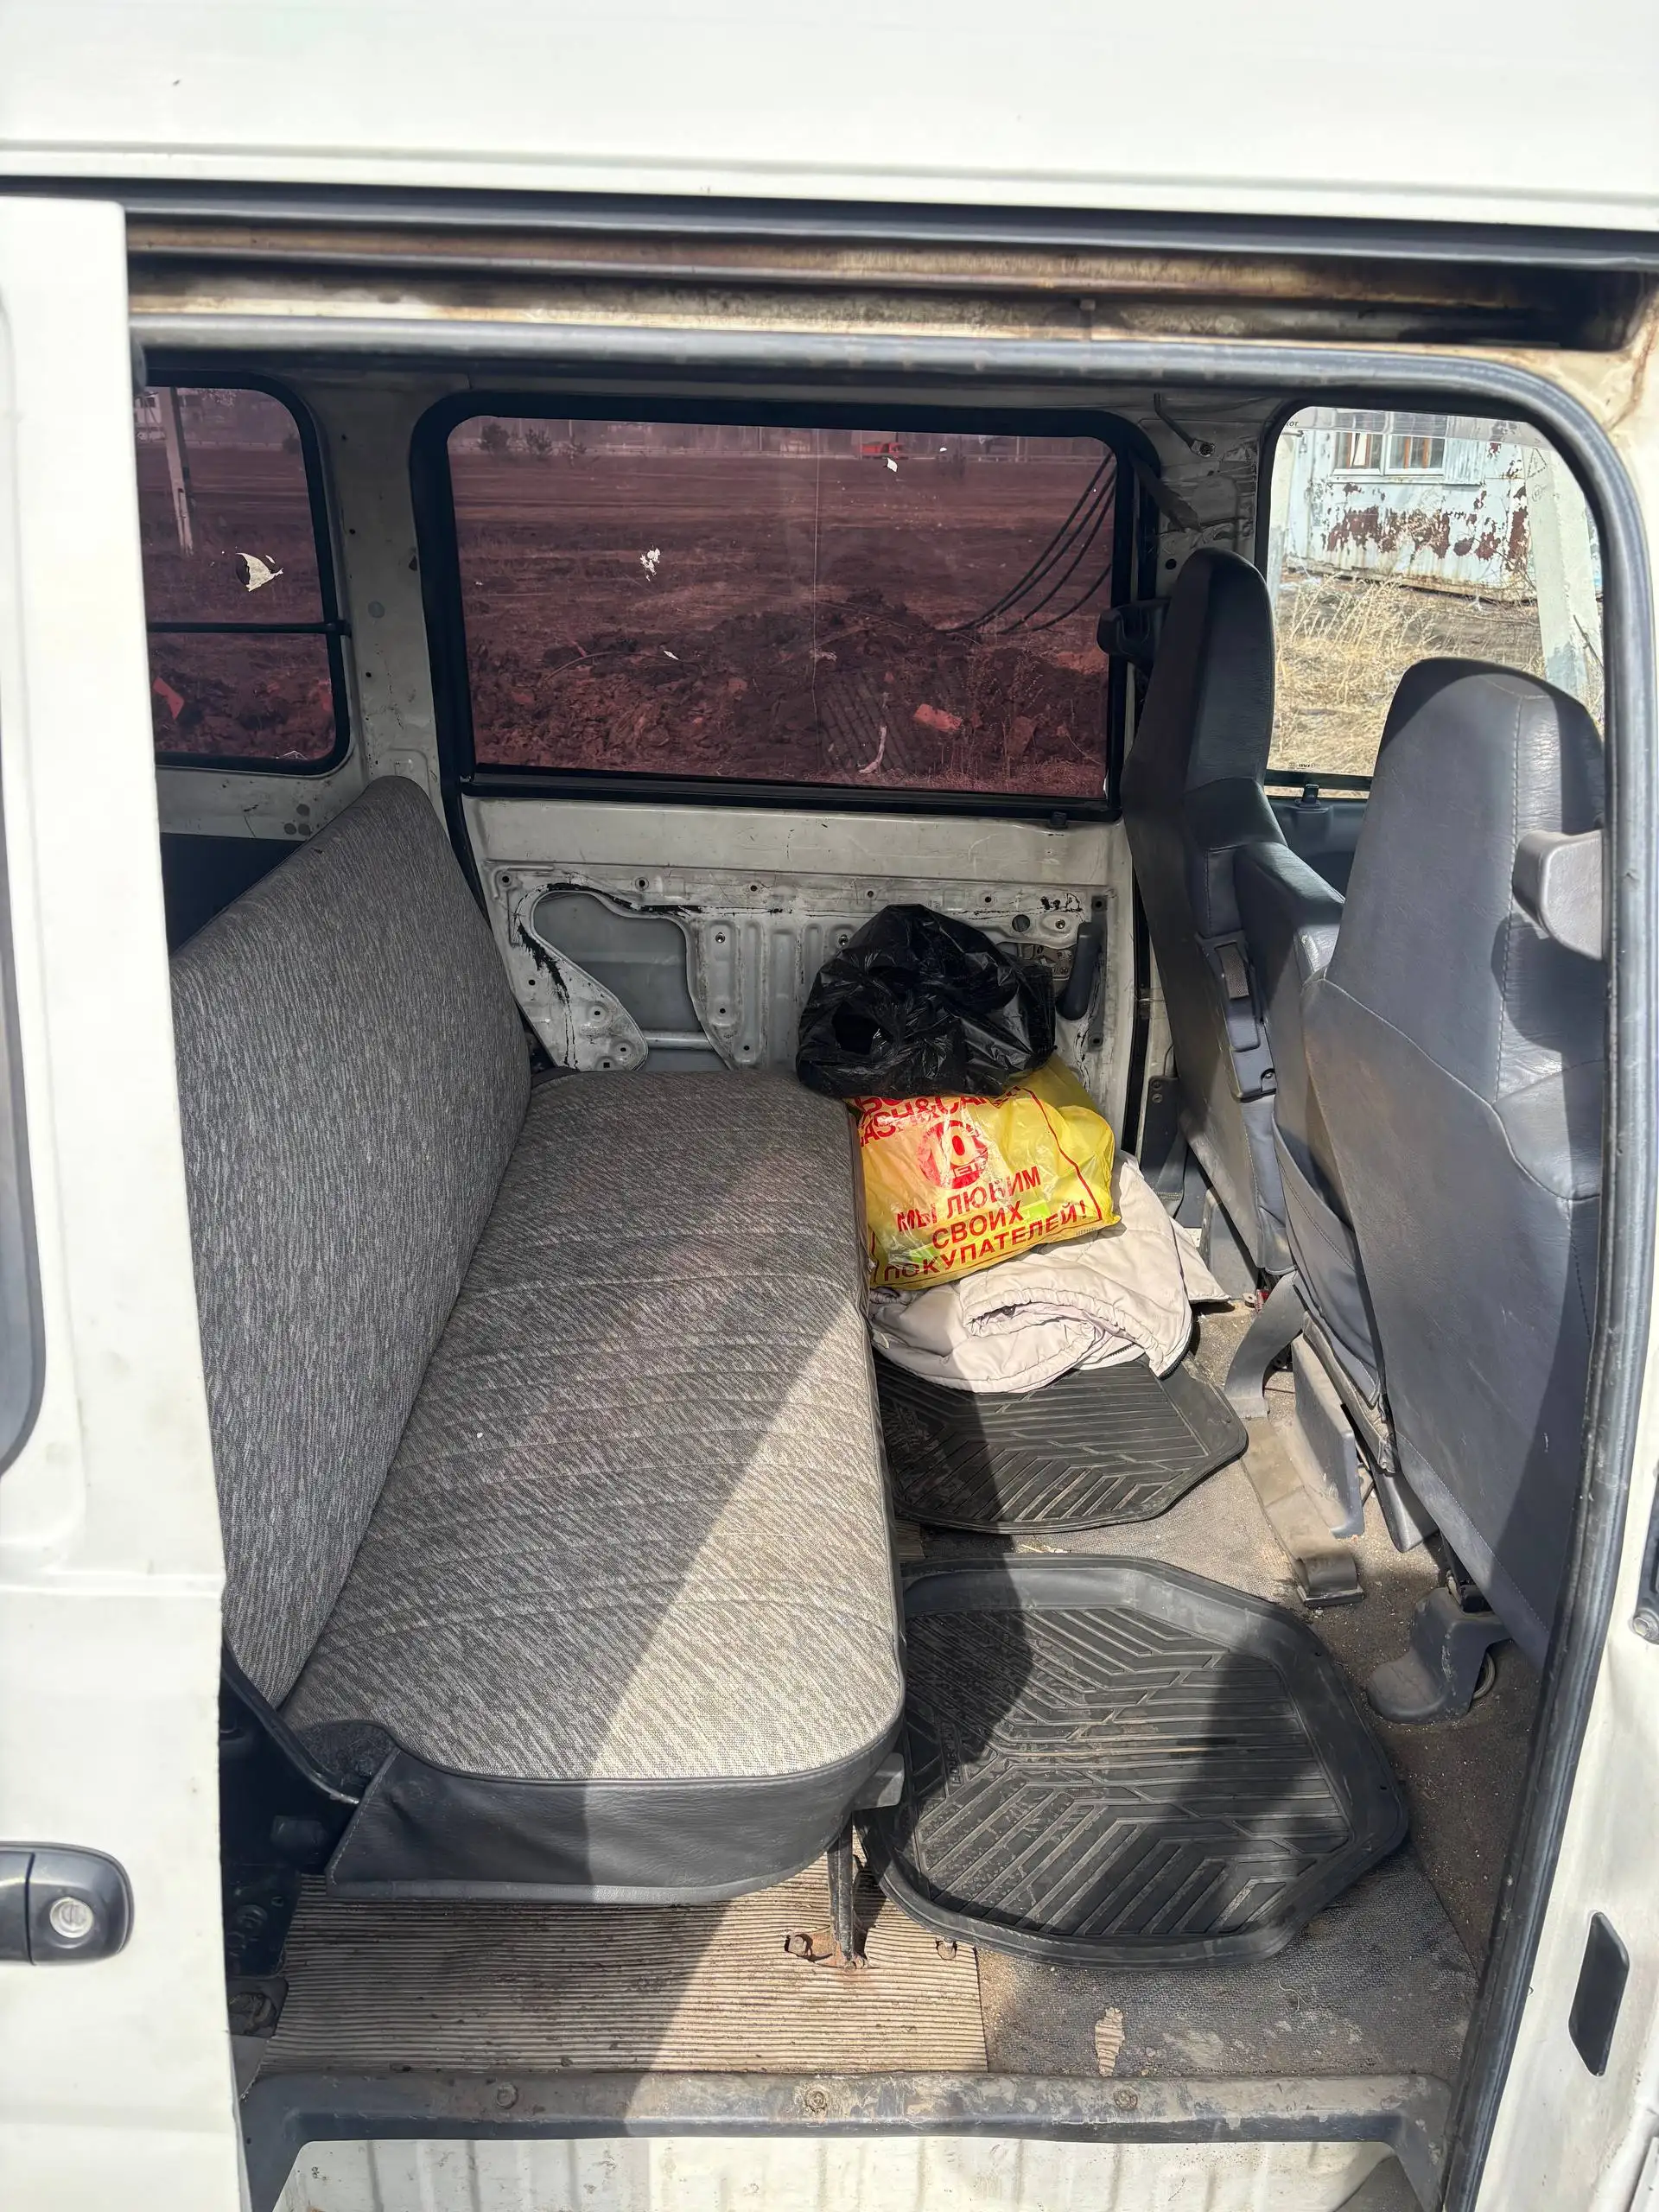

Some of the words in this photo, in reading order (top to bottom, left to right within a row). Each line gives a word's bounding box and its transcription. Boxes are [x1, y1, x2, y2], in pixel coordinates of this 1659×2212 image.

[884, 1199, 1087, 1281] ПОКУПАТЕЛЕЙ!
[897, 1204, 938, 1232] МЫ
[932, 1200, 1024, 1249] СВОИХ
